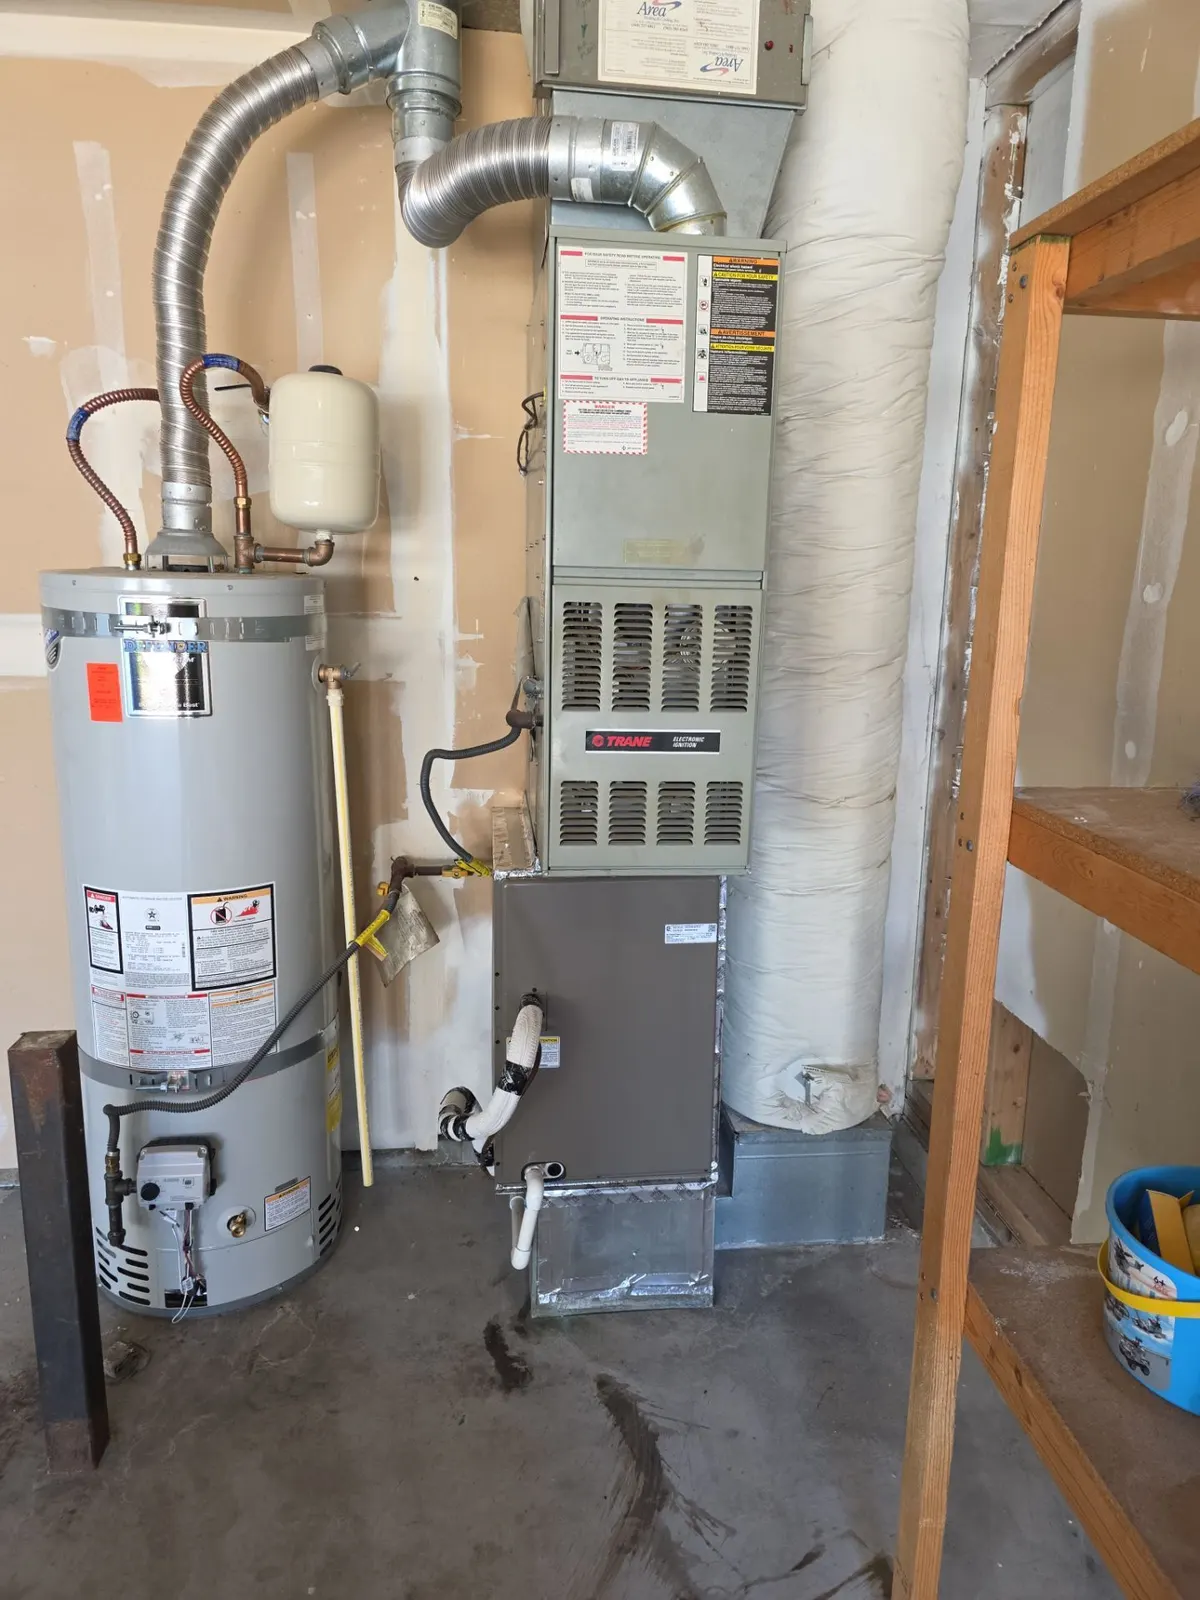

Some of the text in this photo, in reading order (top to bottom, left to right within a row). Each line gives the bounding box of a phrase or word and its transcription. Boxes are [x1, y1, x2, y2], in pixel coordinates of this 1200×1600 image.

[636, 1, 667, 17] Area
[714, 56, 744, 73] Area
[123, 638, 209, 653] DEFENDER
[606, 735, 653, 748] TRANE
[223, 894, 248, 902] WARNING
[1153, 1276, 1166, 1286] 6+
